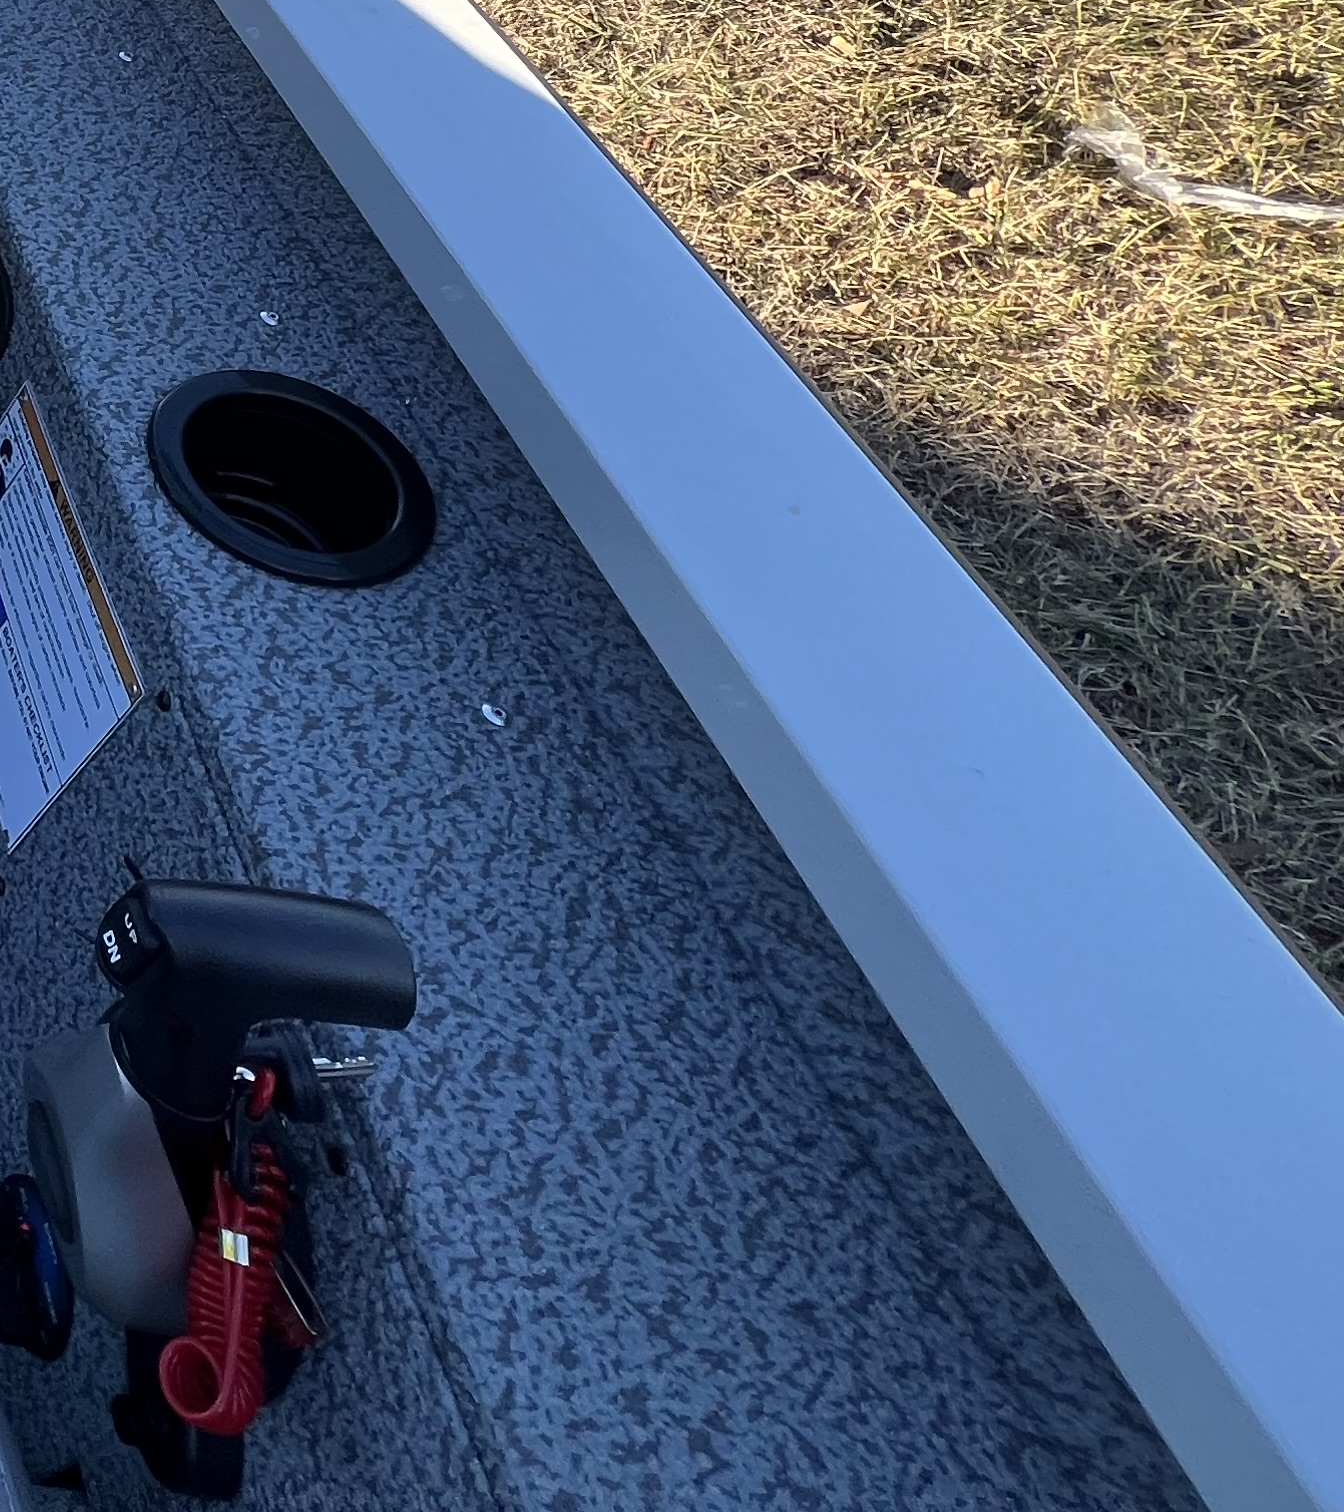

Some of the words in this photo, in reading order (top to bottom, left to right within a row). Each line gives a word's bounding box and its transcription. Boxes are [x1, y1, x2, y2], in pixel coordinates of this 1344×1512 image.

[60, 500, 94, 584] WARNING
[23, 695, 54, 773] CHECKLIST
[102, 929, 121, 964] DN
